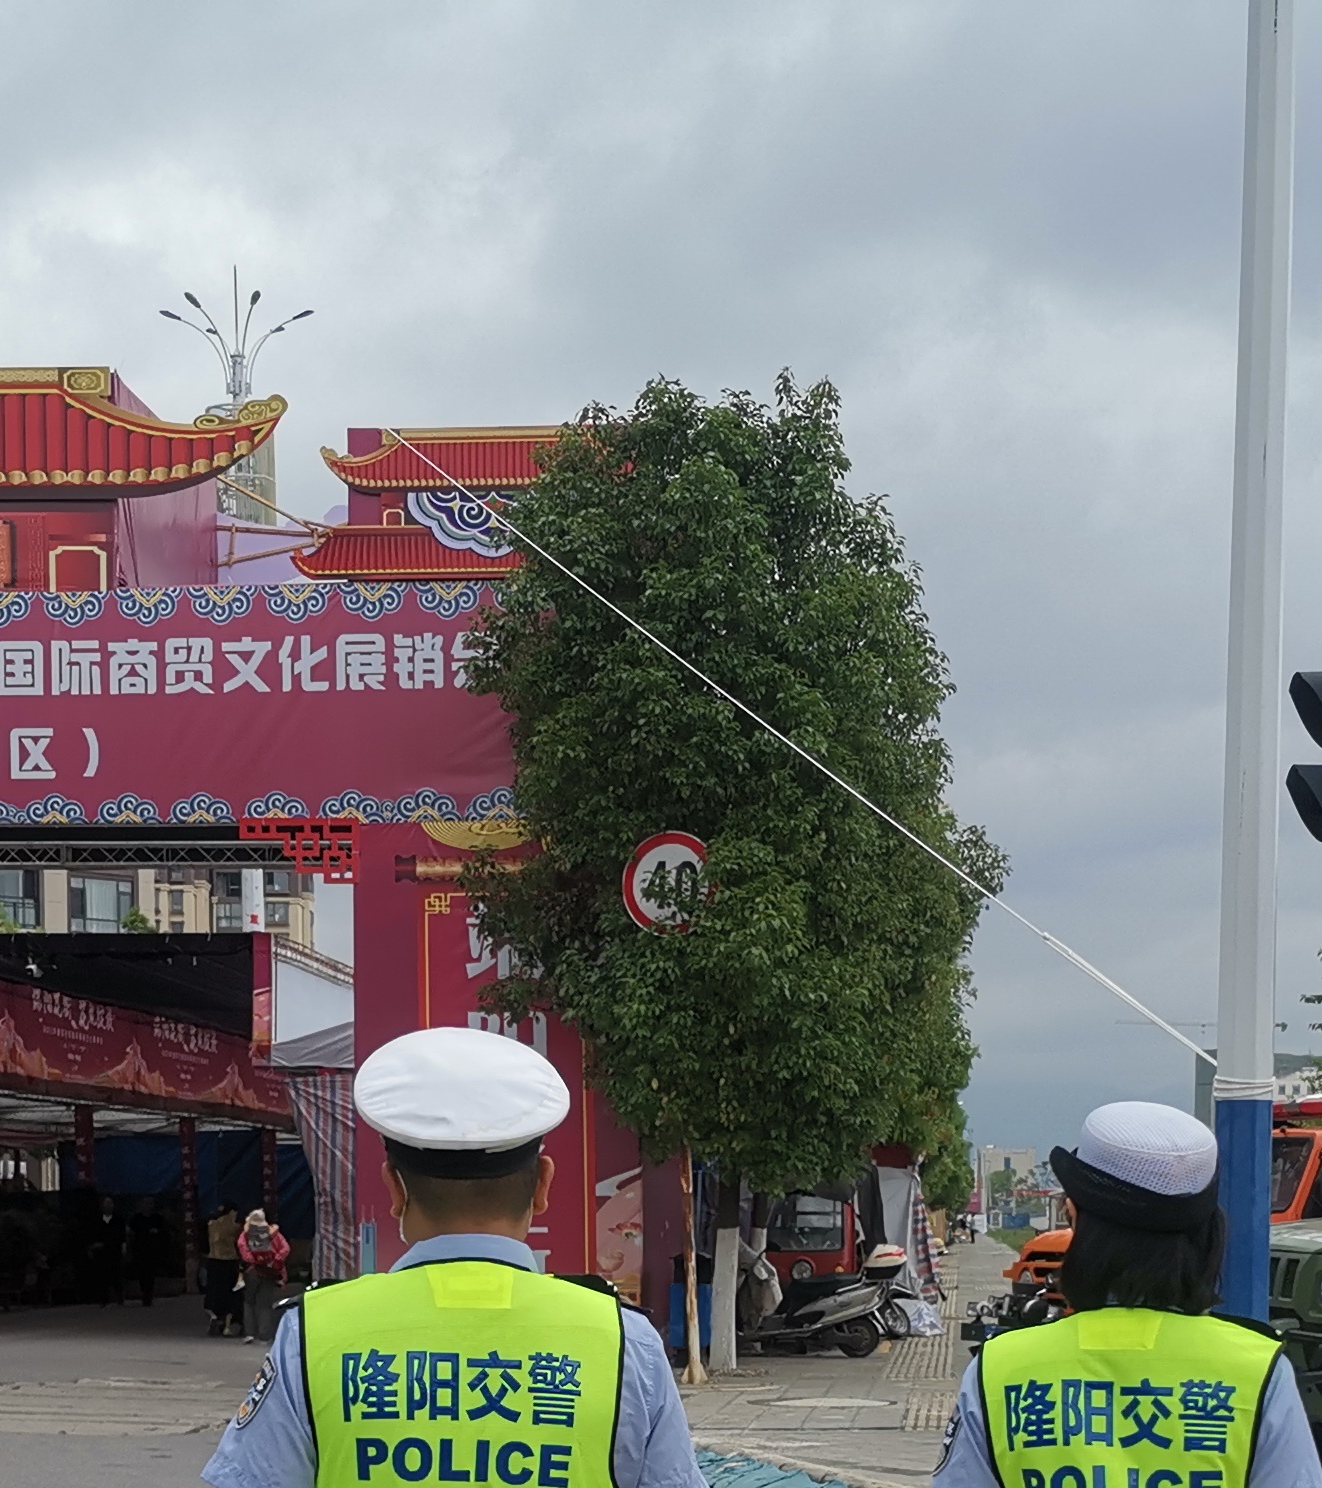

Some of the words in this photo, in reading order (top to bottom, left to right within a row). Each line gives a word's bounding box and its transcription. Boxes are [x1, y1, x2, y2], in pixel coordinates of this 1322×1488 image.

[341, 1347, 582, 1428] 隆阳交警
[1004, 1378, 1237, 1455] 隆阳交警
